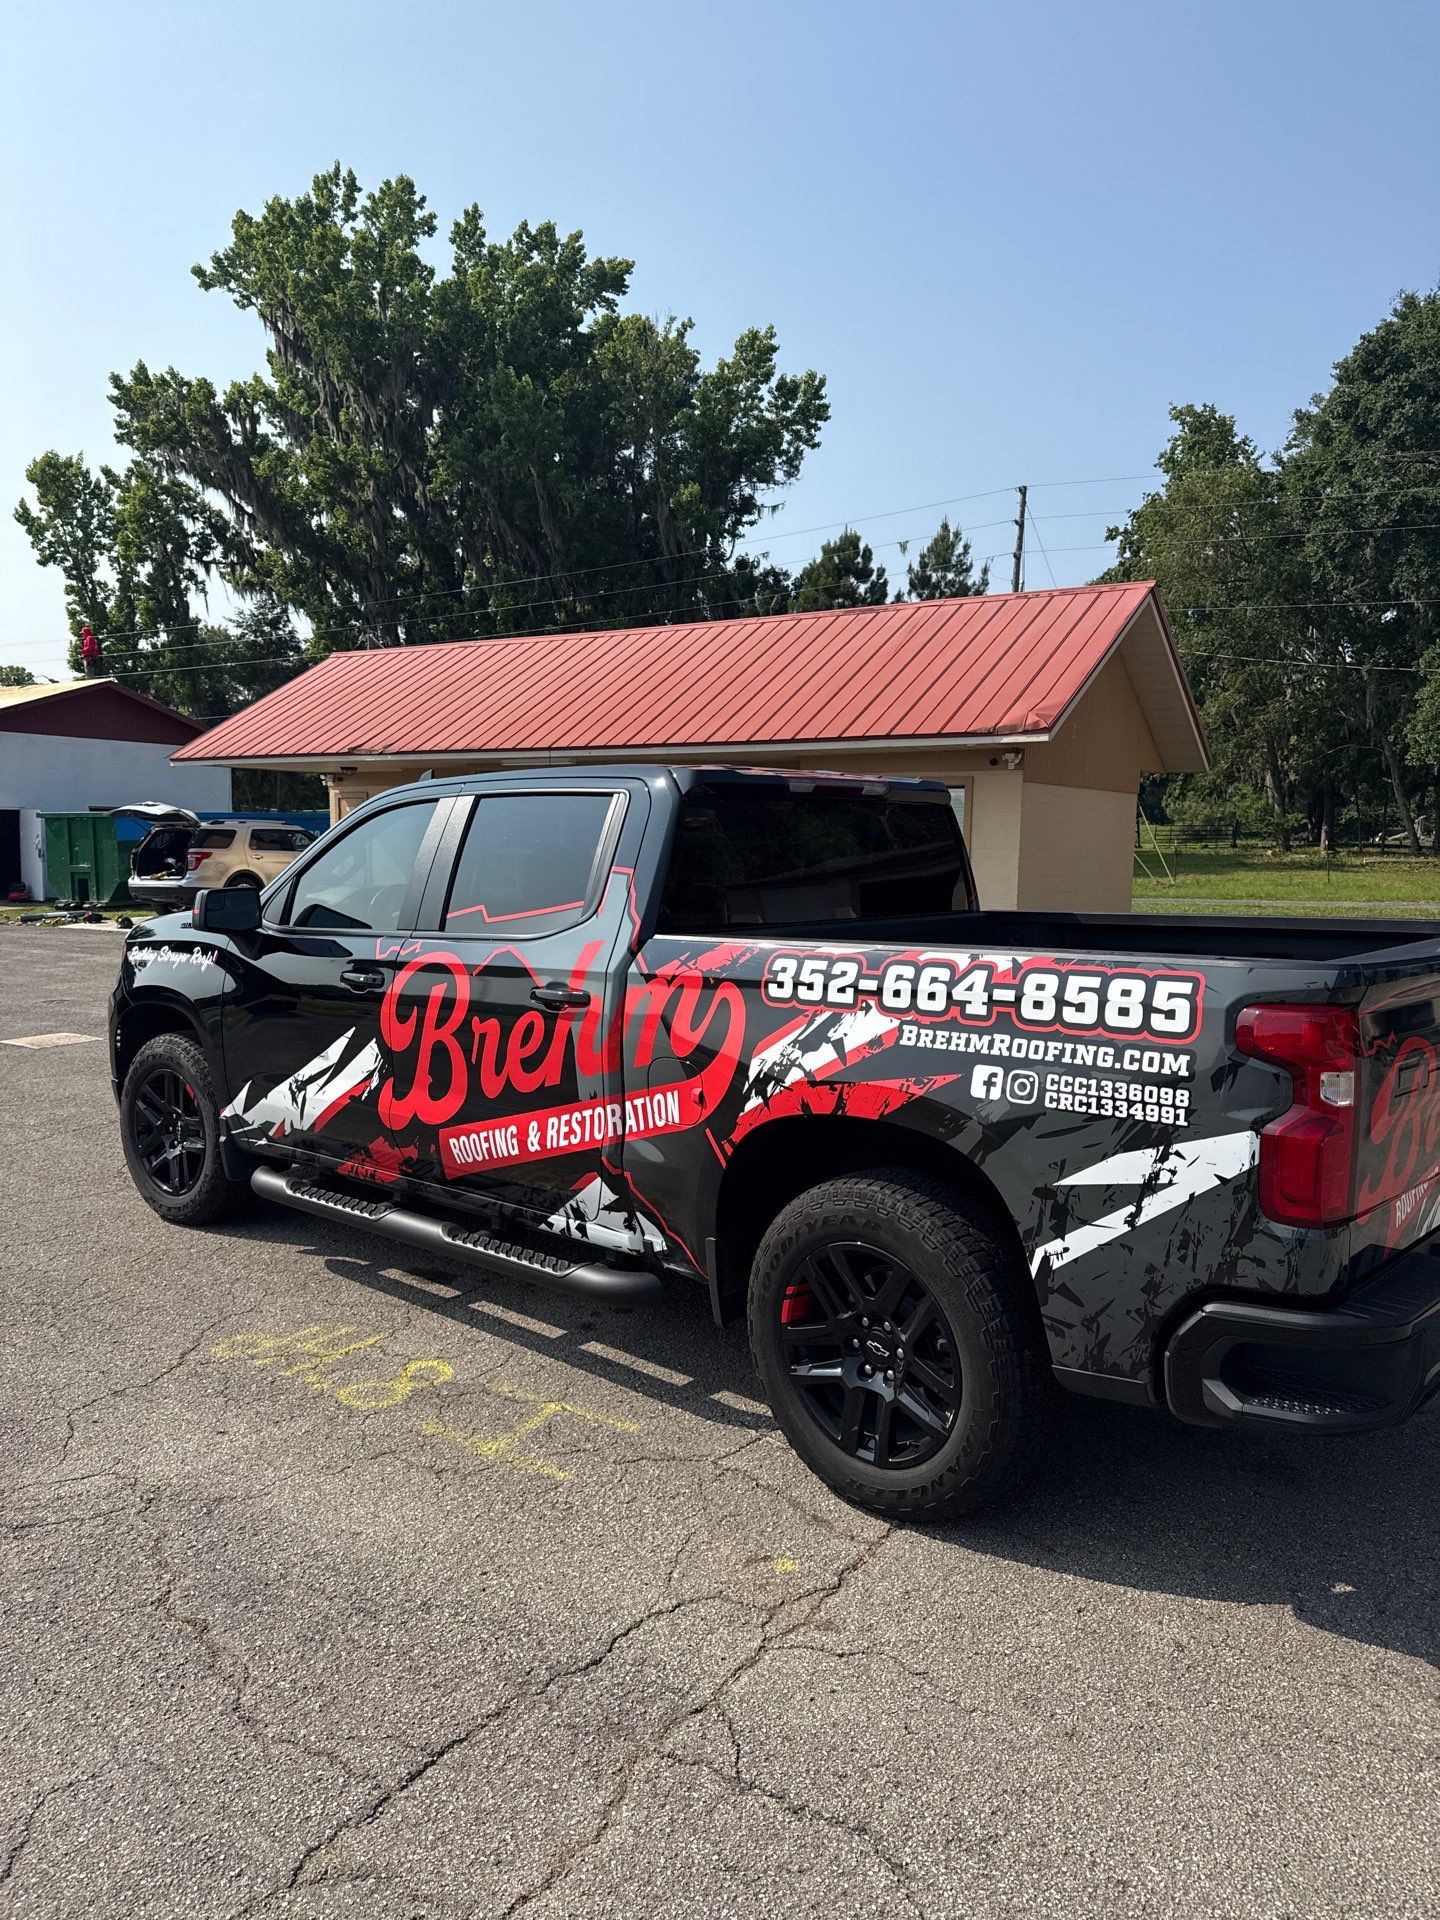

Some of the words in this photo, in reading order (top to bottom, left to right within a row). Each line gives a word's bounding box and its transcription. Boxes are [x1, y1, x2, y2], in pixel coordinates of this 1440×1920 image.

[767, 957, 1195, 1034] 352-664-8585
[377, 940, 746, 1131] Brehm
[899, 1025, 1191, 1077] BREHMROOFING.COM
[1044, 1093, 1189, 1126] CRC1334991
[1045, 1074, 1190, 1107] CCC1336098
[448, 1125, 519, 1165] ROOFING
[526, 1123, 542, 1153] &
[546, 1089, 681, 1149] RESTORATION
